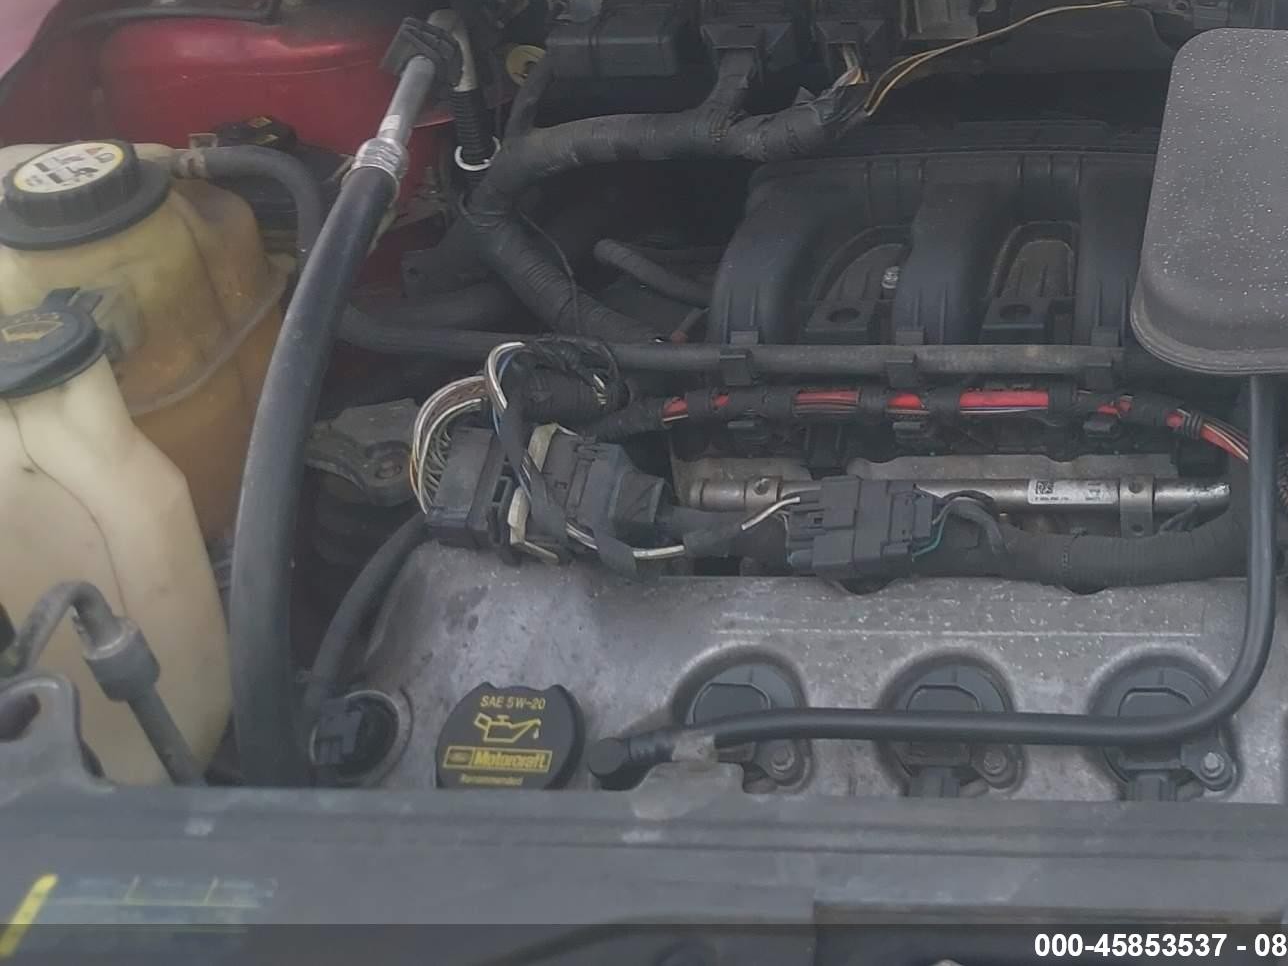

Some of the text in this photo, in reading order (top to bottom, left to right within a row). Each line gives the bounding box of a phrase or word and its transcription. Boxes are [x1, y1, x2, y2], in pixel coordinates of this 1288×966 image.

[480, 694, 546, 711] SAE 5W-20
[473, 749, 546, 769] Motorcraft
